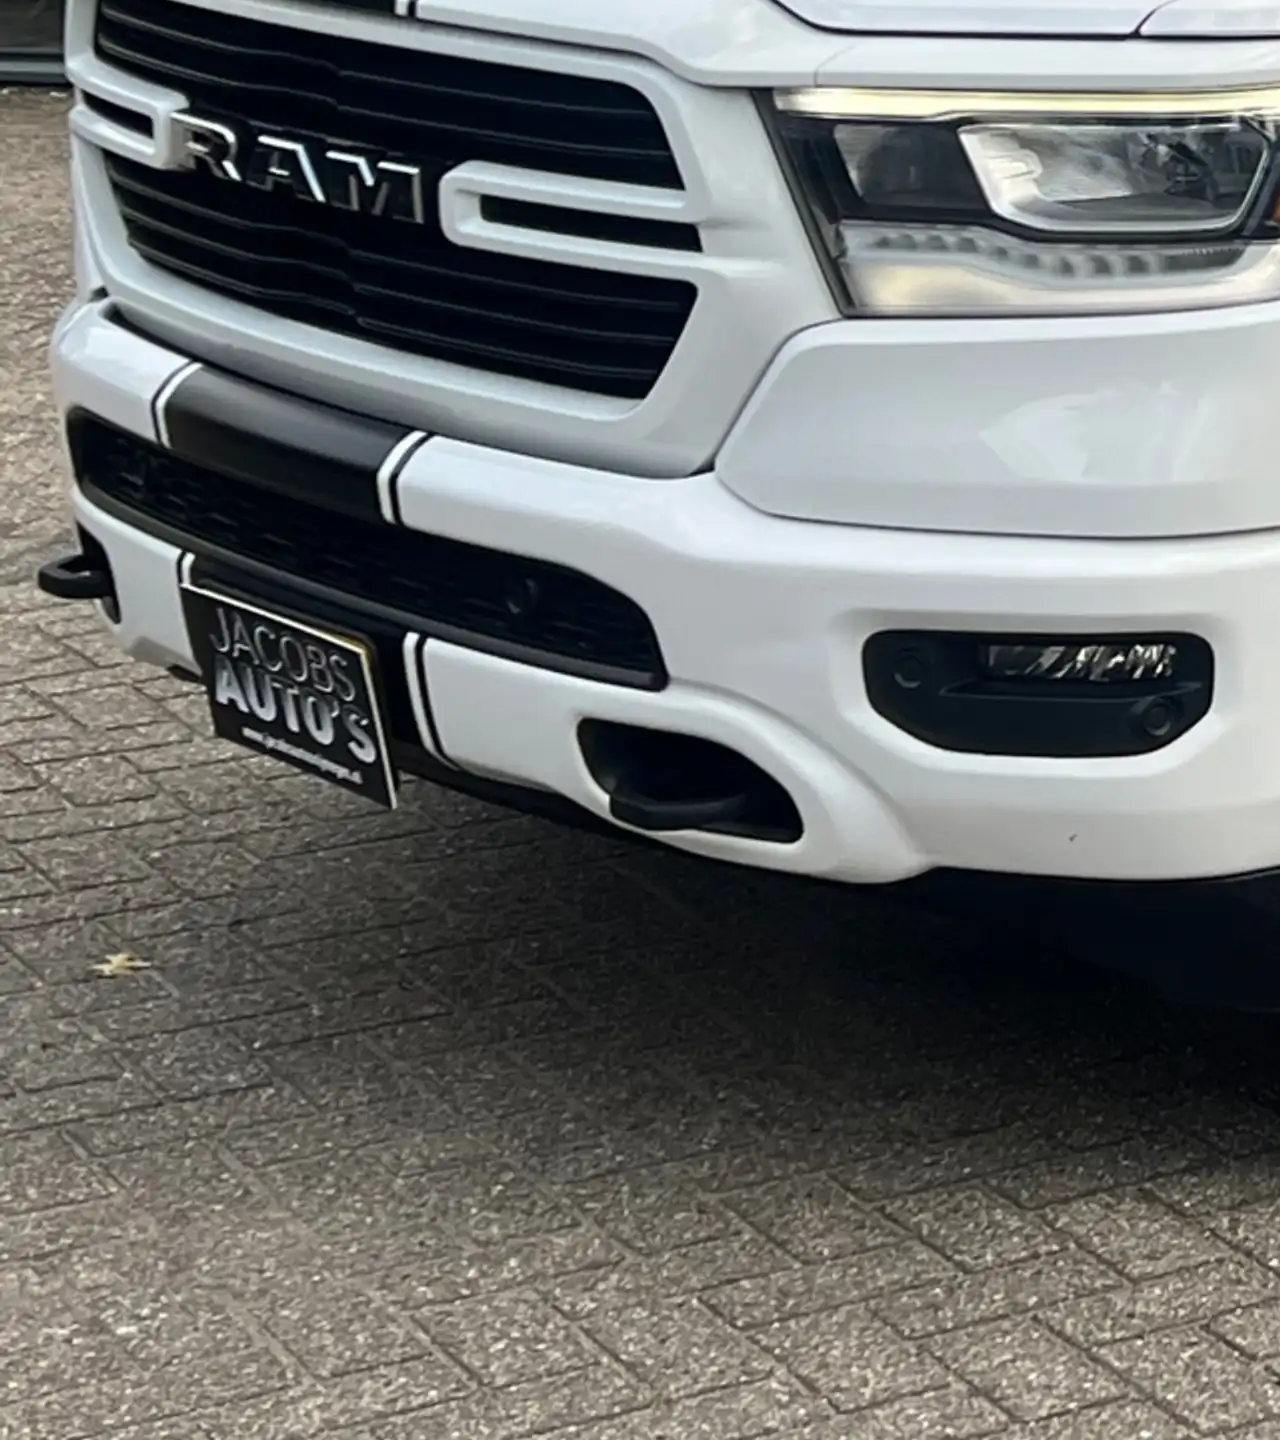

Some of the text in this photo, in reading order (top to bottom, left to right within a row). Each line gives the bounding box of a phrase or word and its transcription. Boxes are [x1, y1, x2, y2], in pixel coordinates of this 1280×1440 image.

[169, 110, 425, 225] RAM
[208, 607, 356, 702] JACOBS
[215, 653, 377, 764] AUTO'S
